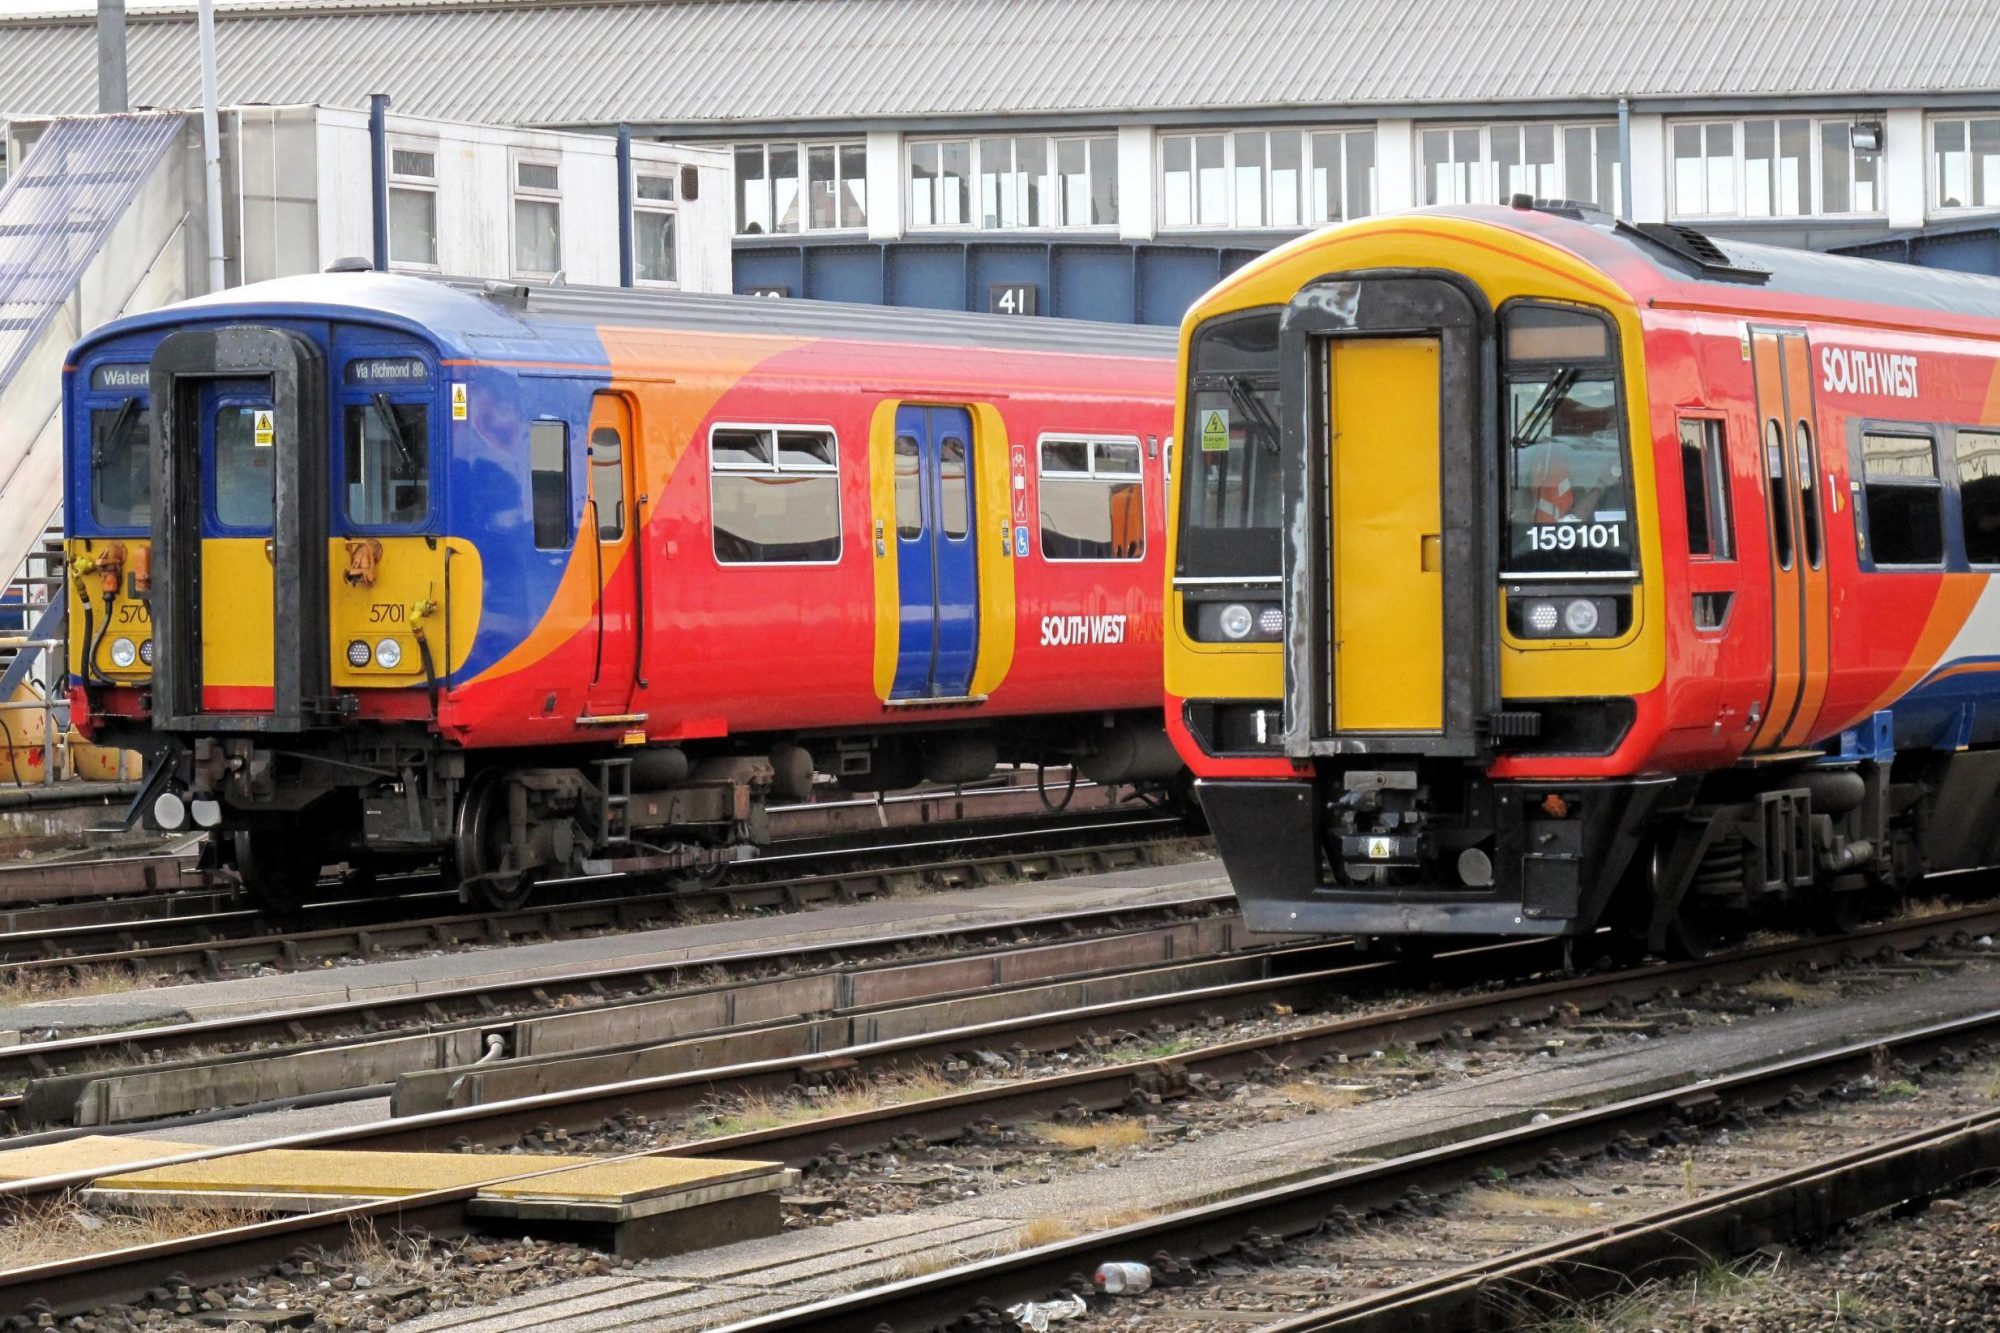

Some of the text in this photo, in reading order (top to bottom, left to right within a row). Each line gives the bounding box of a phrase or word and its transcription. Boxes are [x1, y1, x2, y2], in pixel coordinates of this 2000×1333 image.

[999, 288, 1024, 314] 41
[355, 363, 368, 378] Via
[371, 361, 409, 378] Richmond
[1821, 346, 1879, 395] SOUTH
[1876, 352, 1918, 398] WEST
[1526, 524, 1620, 550] 159101
[369, 603, 405, 623] 5701
[1040, 615, 1089, 646] SOUTH
[1090, 615, 1127, 644] WEST
